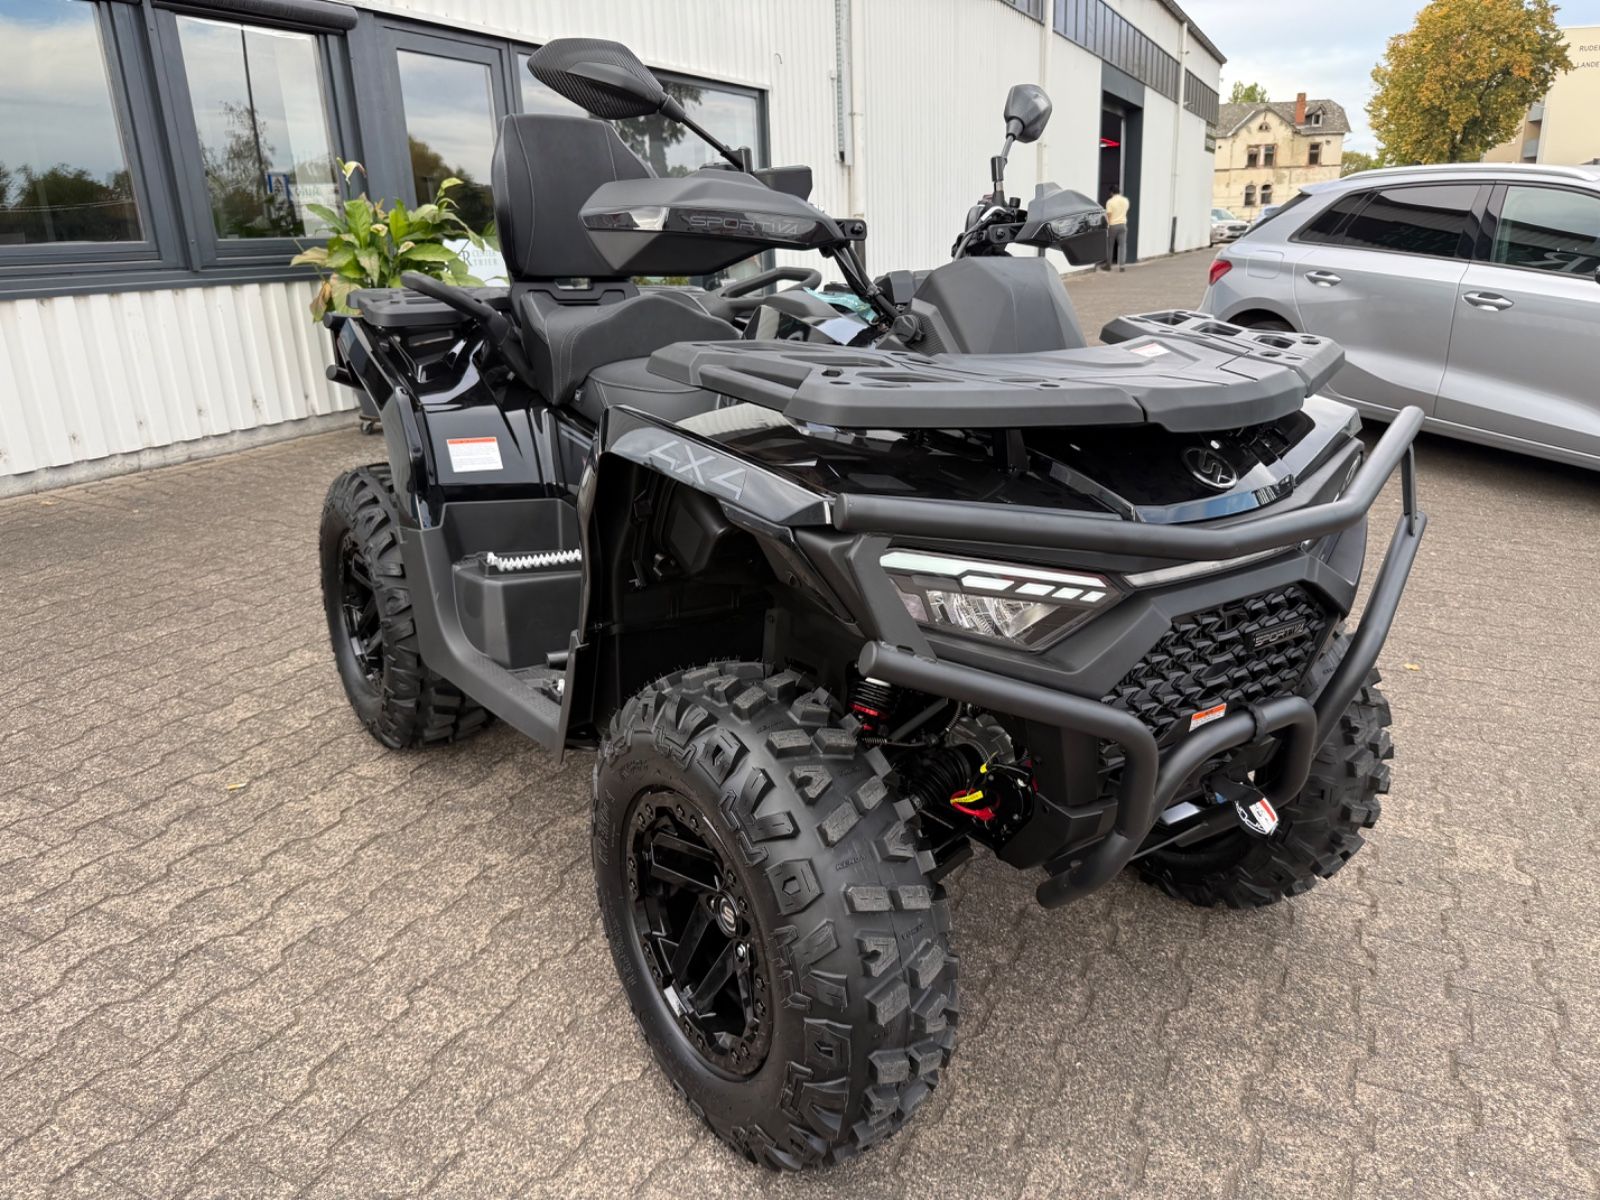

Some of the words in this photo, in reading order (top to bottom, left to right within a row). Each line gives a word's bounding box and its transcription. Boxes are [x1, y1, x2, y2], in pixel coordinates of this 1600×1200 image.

[689, 215, 799, 235] SPORTIVA
[644, 439, 747, 501] 4X4
[1253, 622, 1305, 648] SPORTIVA
